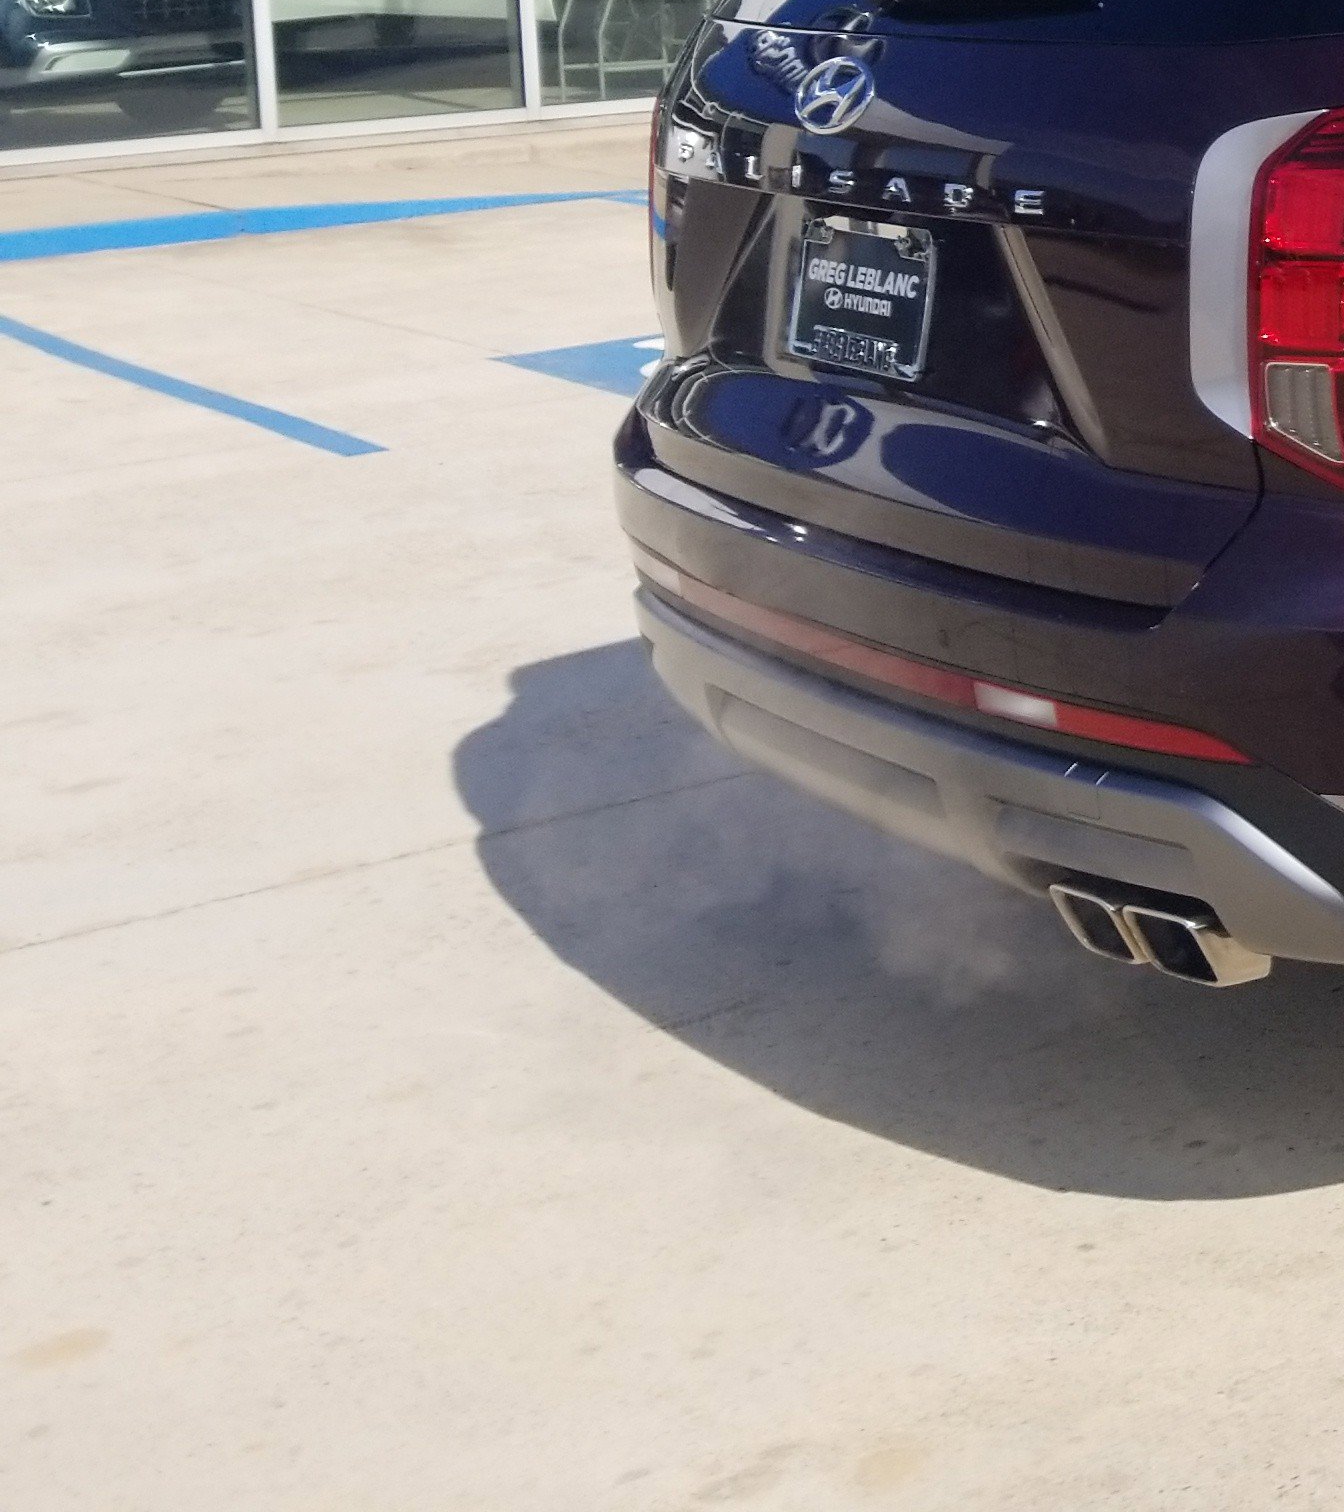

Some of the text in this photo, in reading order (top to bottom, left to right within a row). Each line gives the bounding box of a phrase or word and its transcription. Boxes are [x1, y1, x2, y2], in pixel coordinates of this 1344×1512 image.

[678, 143, 1045, 215] PALISADE
[808, 257, 920, 299] GREG LEBLANC
[843, 292, 892, 317] HYUNDAI
